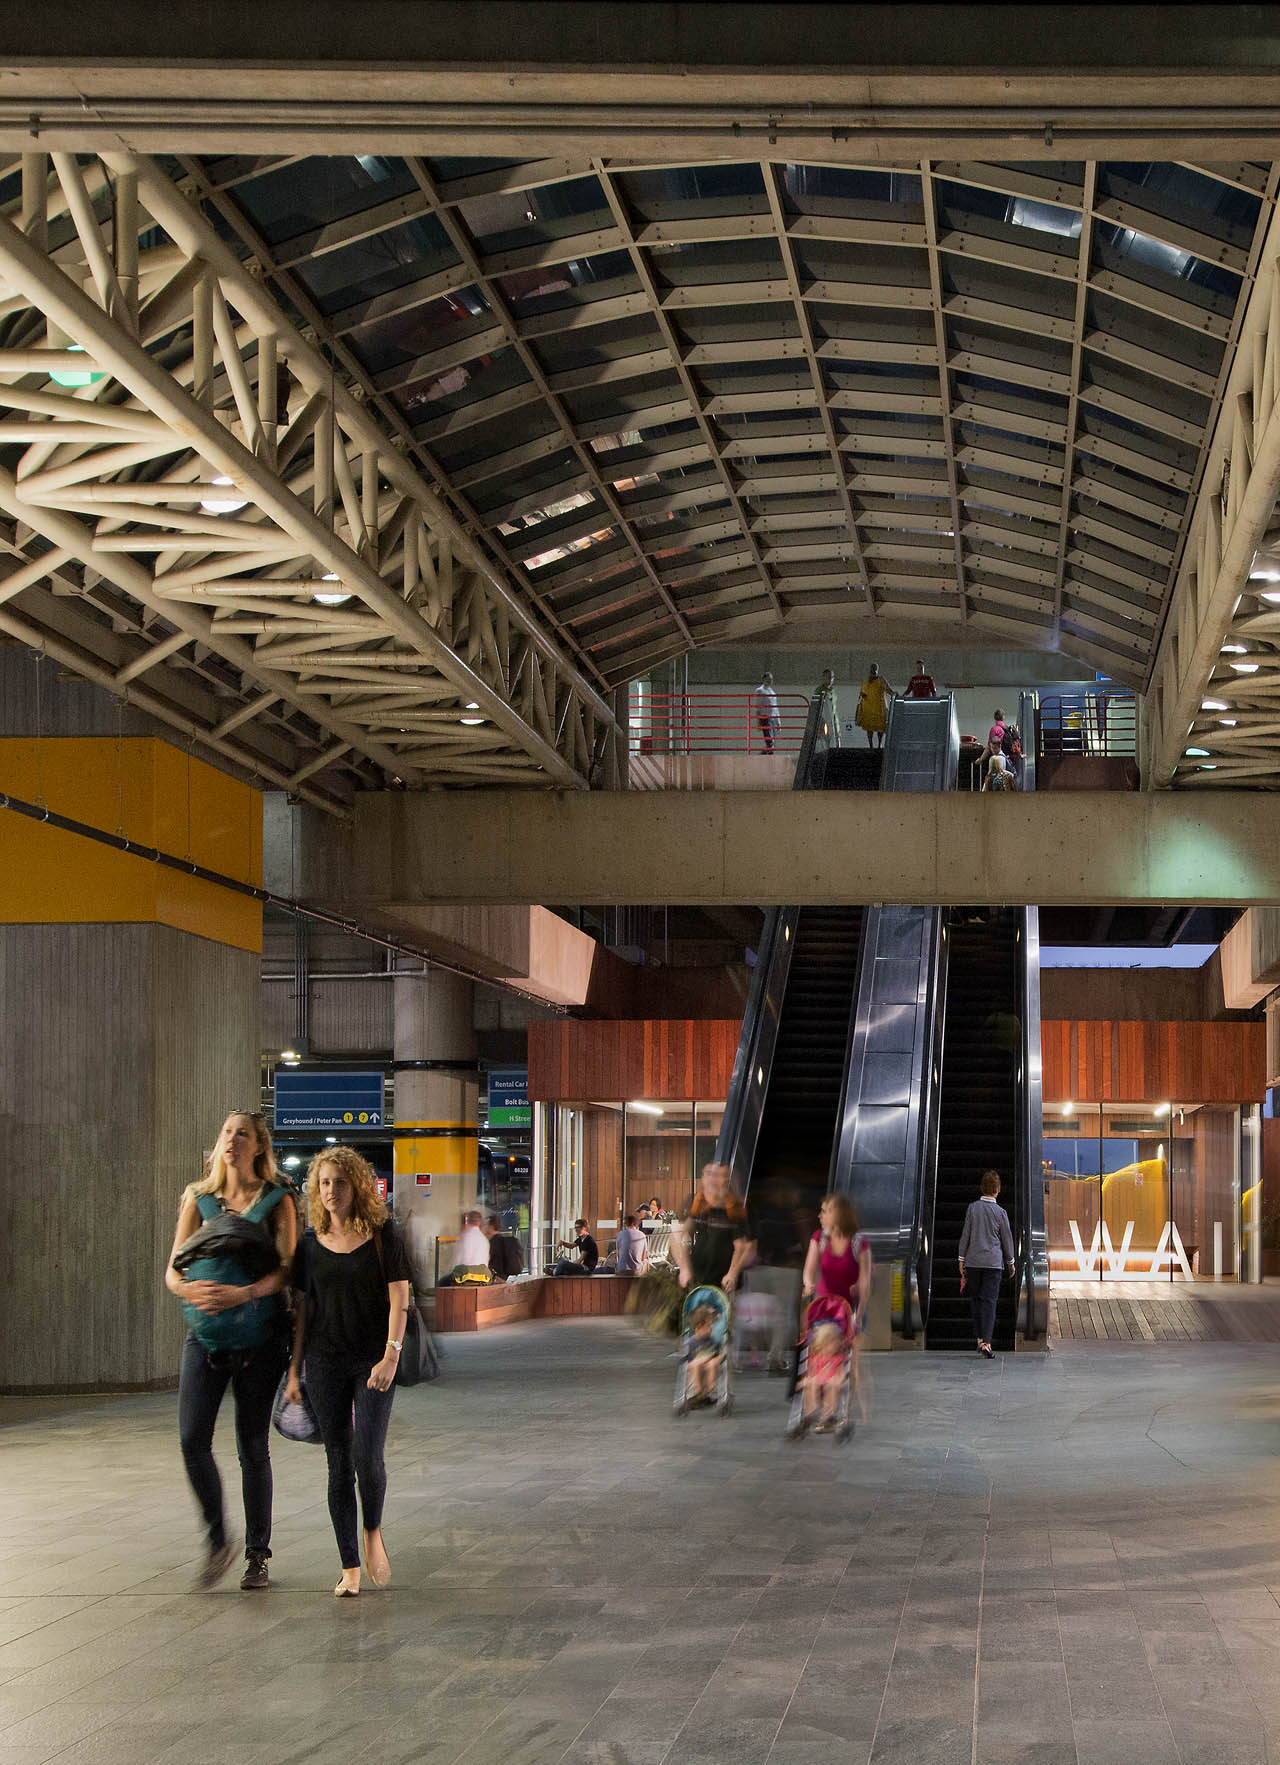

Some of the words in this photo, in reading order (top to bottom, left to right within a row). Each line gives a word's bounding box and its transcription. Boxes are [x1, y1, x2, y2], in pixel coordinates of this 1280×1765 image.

[504, 1098, 517, 1106] Bolt
[518, 1098, 529, 1106] Bus
[282, 1117, 313, 1125] Greyhound
